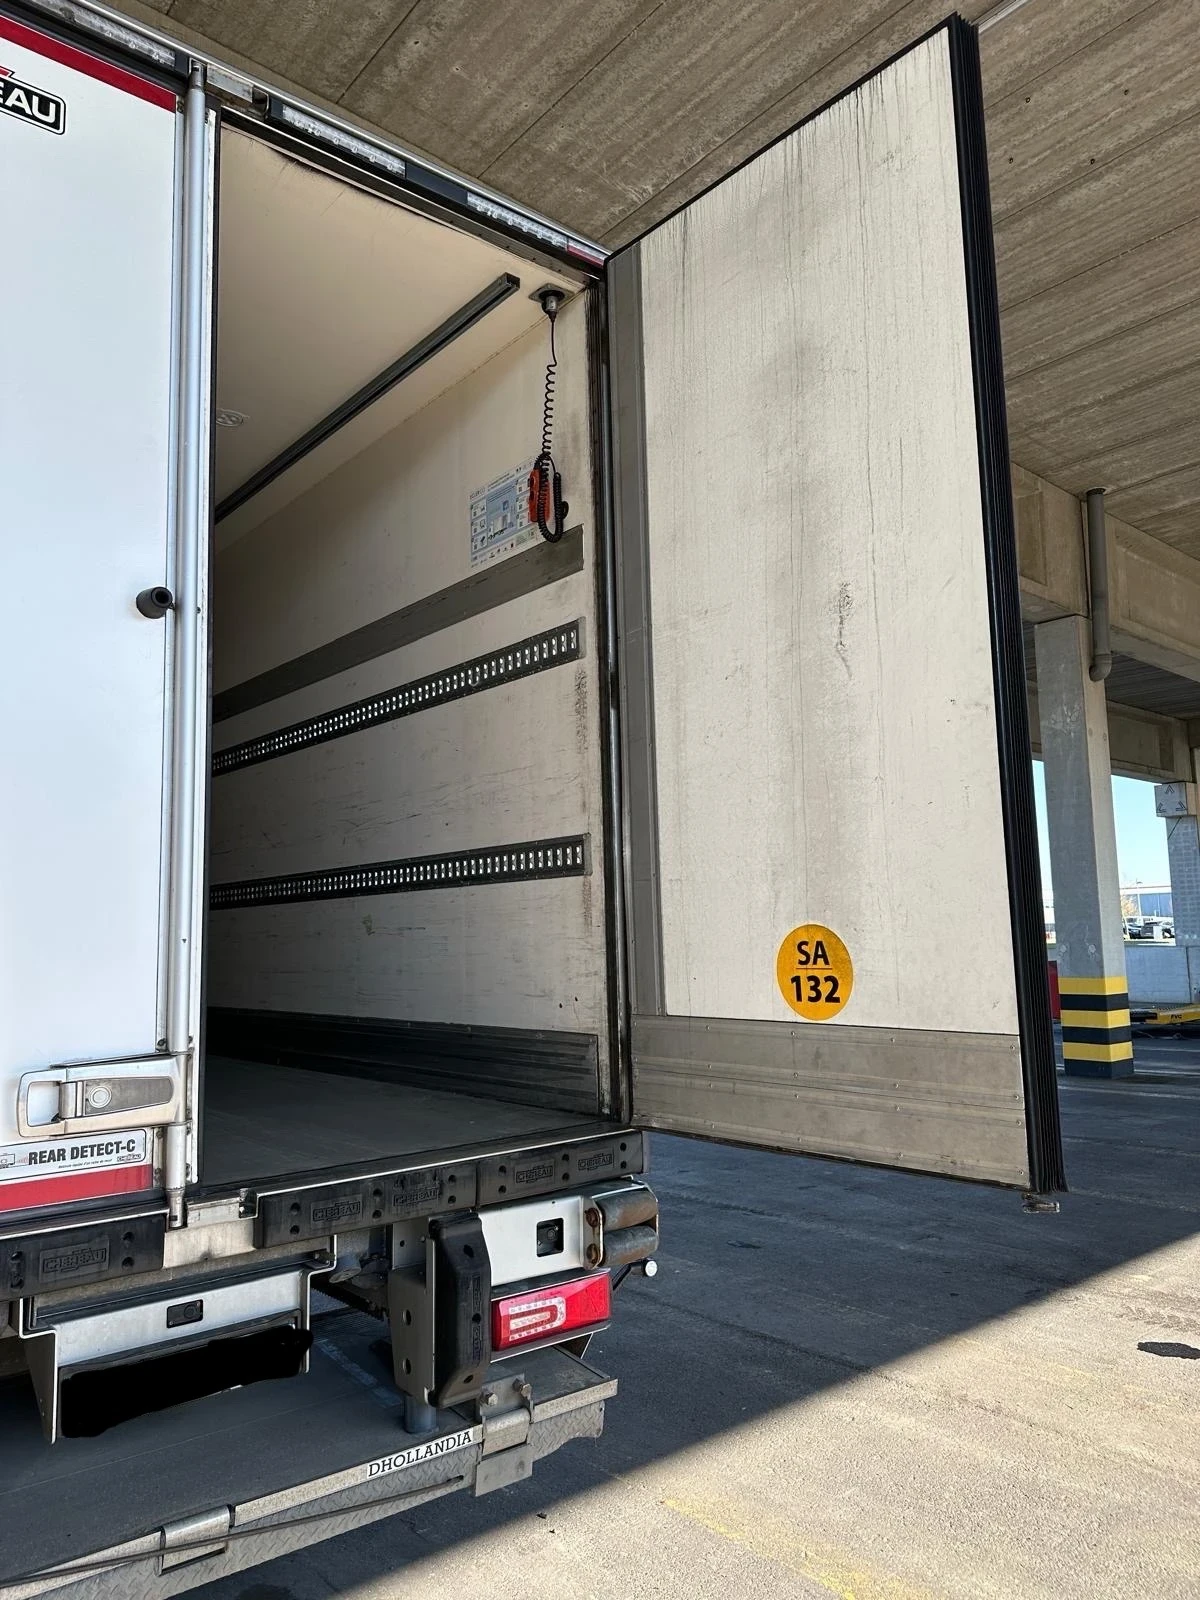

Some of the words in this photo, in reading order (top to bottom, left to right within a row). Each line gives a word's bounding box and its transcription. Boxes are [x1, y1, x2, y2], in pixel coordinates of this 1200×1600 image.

[0, 81, 56, 123] AU
[796, 940, 830, 966] SA
[790, 975, 841, 1004] 132
[28, 1148, 67, 1166] REAR
[70, 1139, 137, 1160] DETECT-C
[368, 1430, 472, 1477] DHOLLANDIA
